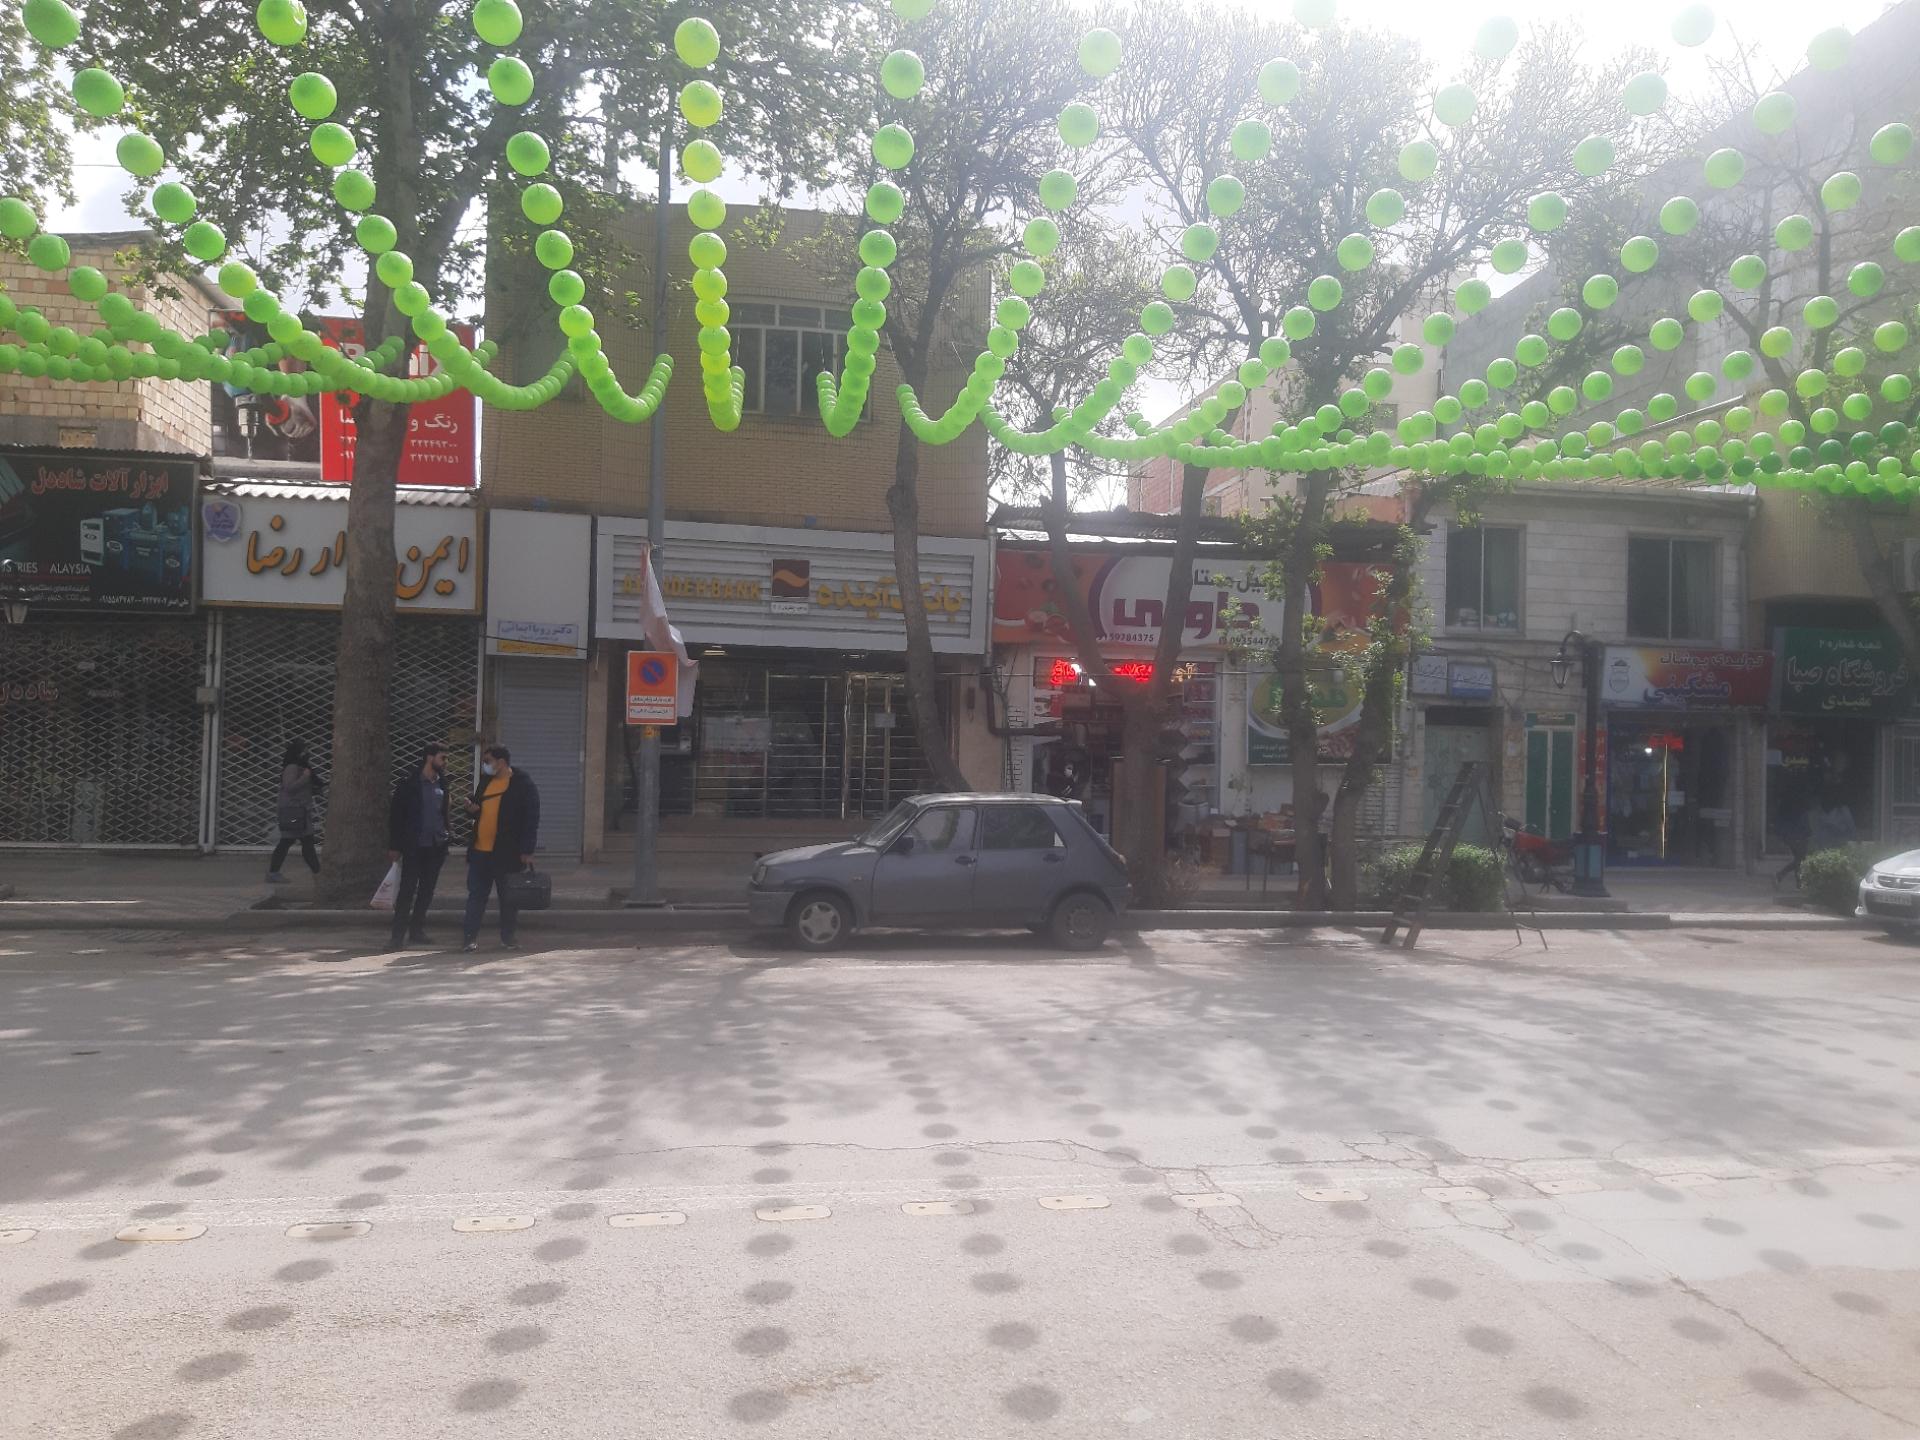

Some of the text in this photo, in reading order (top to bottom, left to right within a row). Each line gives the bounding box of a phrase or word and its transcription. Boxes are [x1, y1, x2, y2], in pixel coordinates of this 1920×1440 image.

[424, 413, 458, 434] رنگ
[89, 467, 131, 492] آلات
[129, 469, 168, 498] ابزار
[246, 514, 302, 576] رضا
[711, 577, 761, 600] BANK
[1659, 650, 1710, 669] پوشاک
[1825, 657, 1908, 696] فروشگاه
